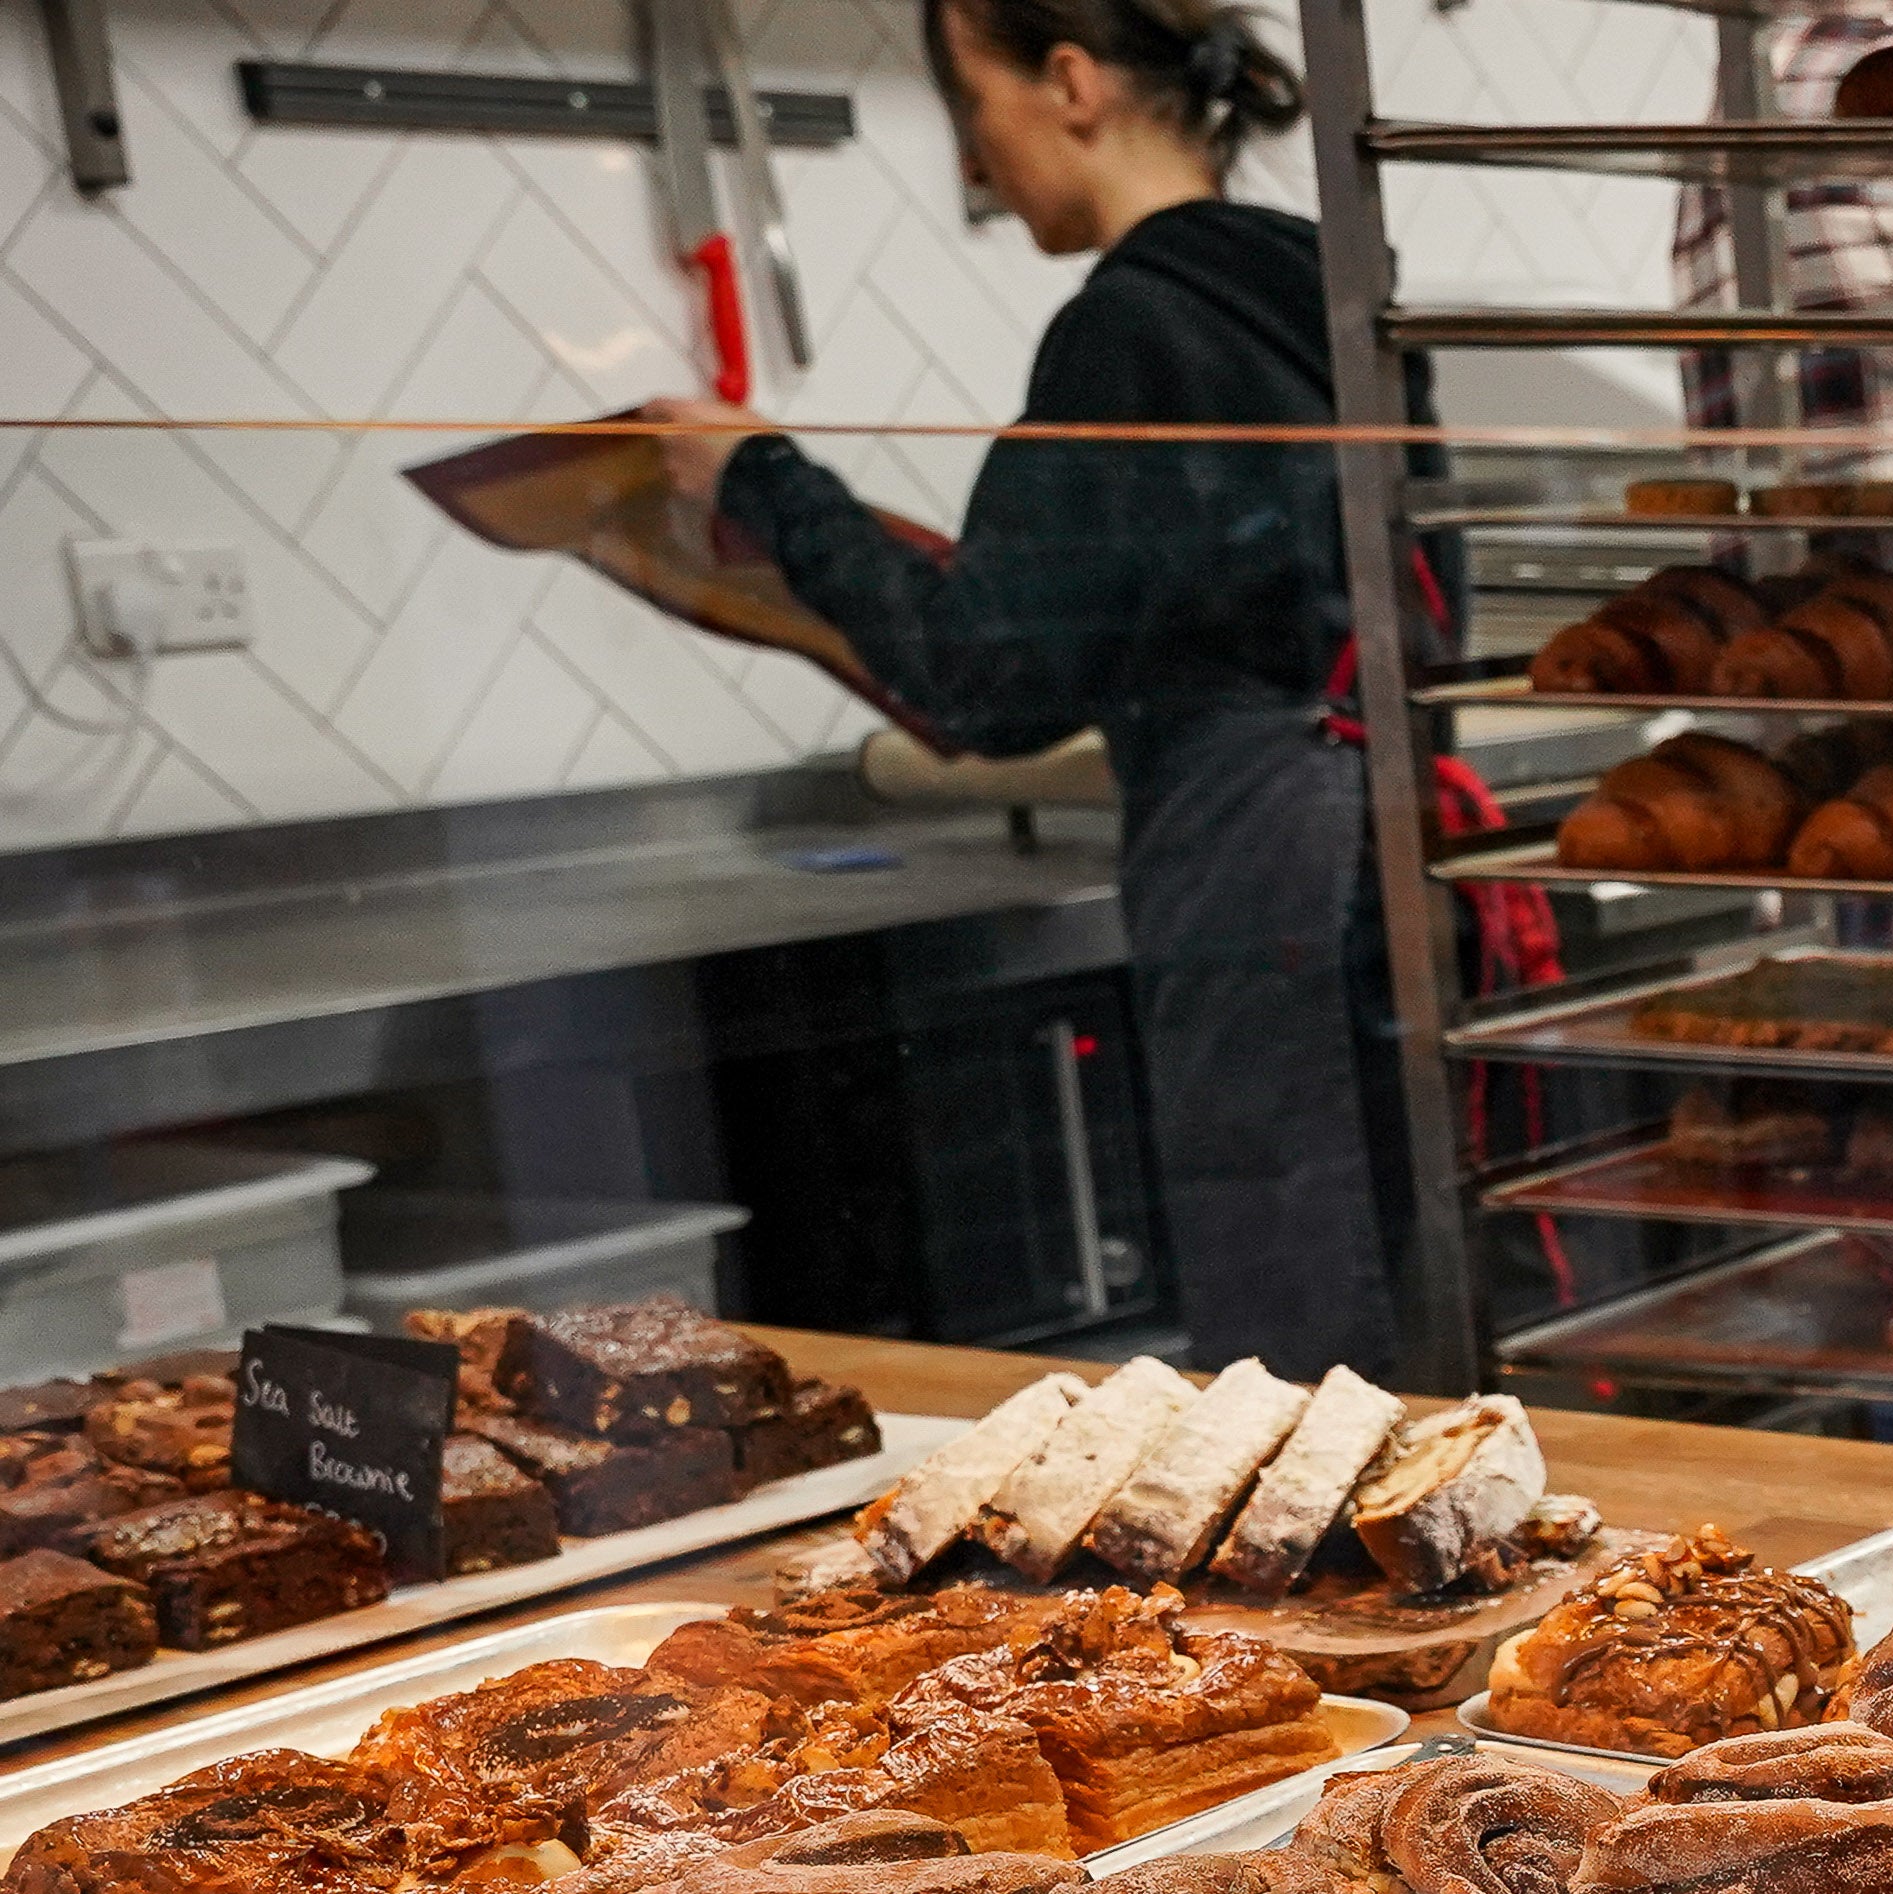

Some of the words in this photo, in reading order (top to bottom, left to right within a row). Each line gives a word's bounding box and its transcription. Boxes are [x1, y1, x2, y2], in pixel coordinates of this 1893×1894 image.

[243, 1358, 290, 1419] Sea
[308, 1390, 360, 1439] Salt
[309, 1440, 415, 1503] Brownie
